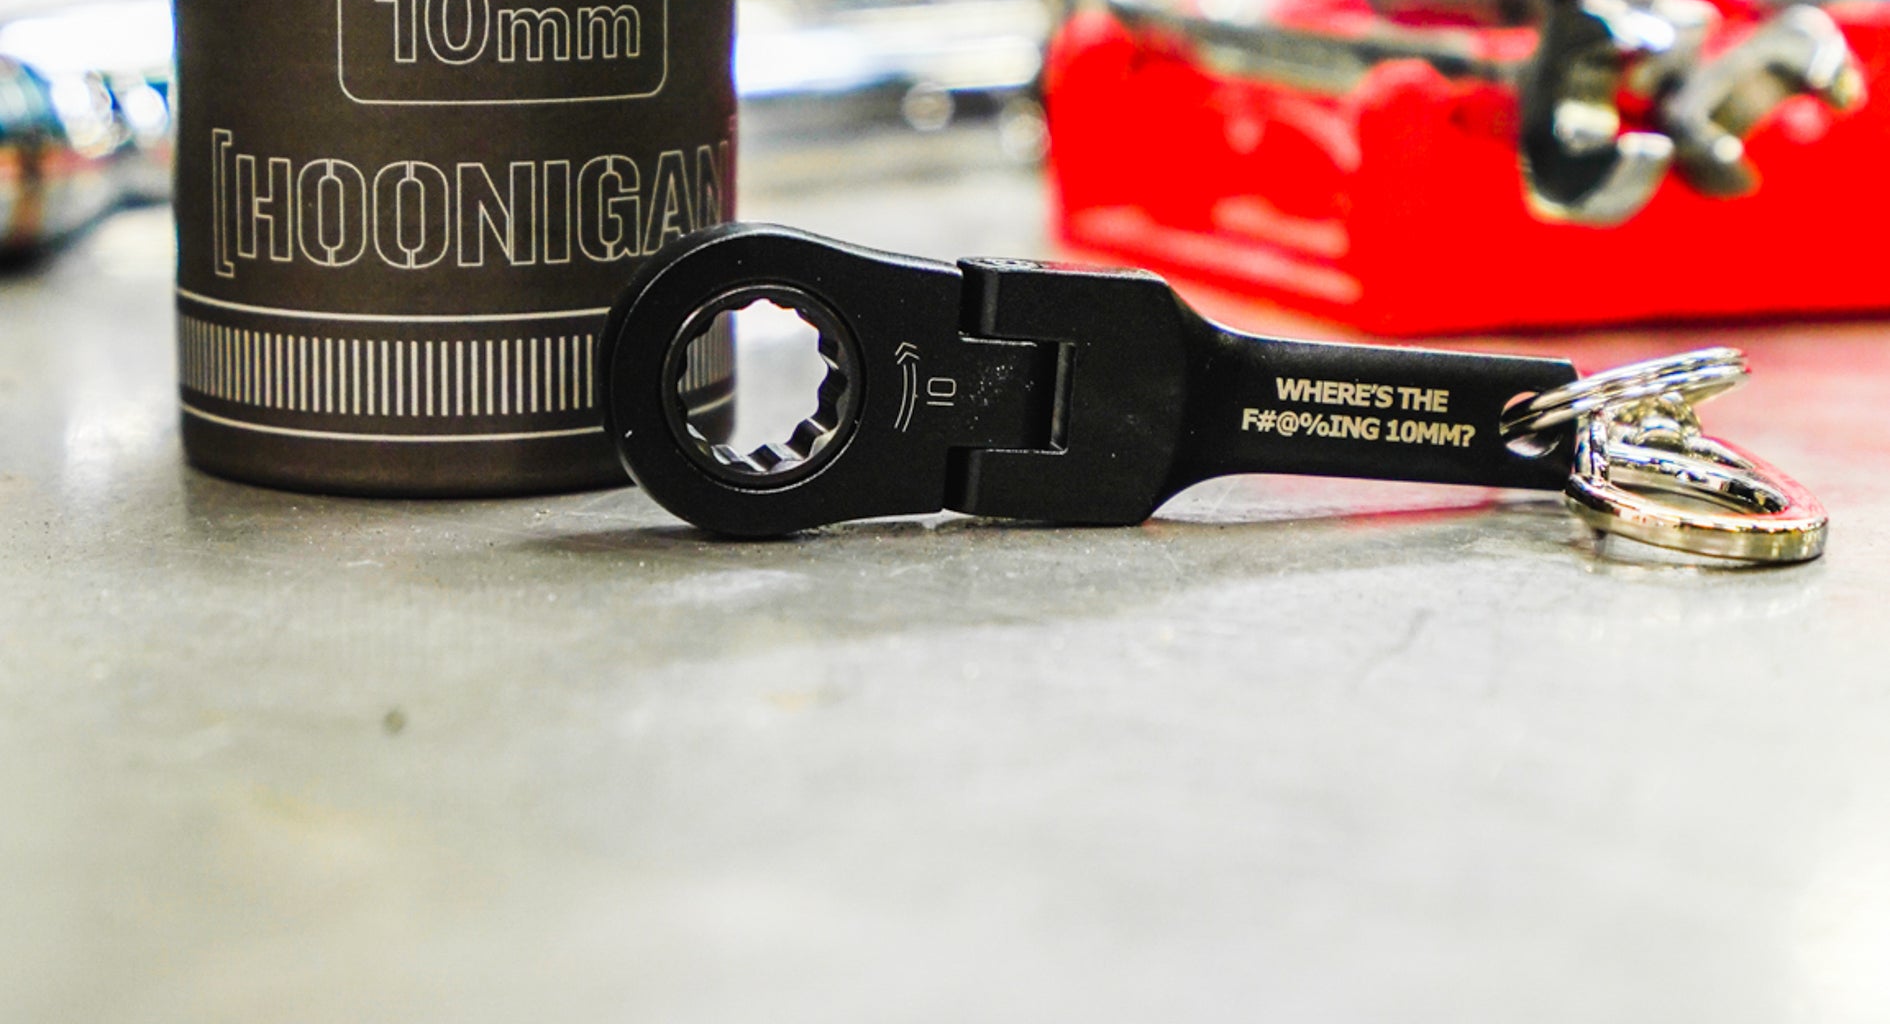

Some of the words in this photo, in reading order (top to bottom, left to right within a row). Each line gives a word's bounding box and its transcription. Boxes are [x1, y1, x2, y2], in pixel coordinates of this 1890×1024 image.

[926, 377, 957, 407] 10
[1275, 377, 1394, 409] WHERE'S
[1397, 387, 1450, 413] THE
[1241, 408, 1381, 441] F#@%ING
[1385, 419, 1476, 448] 10MM?
